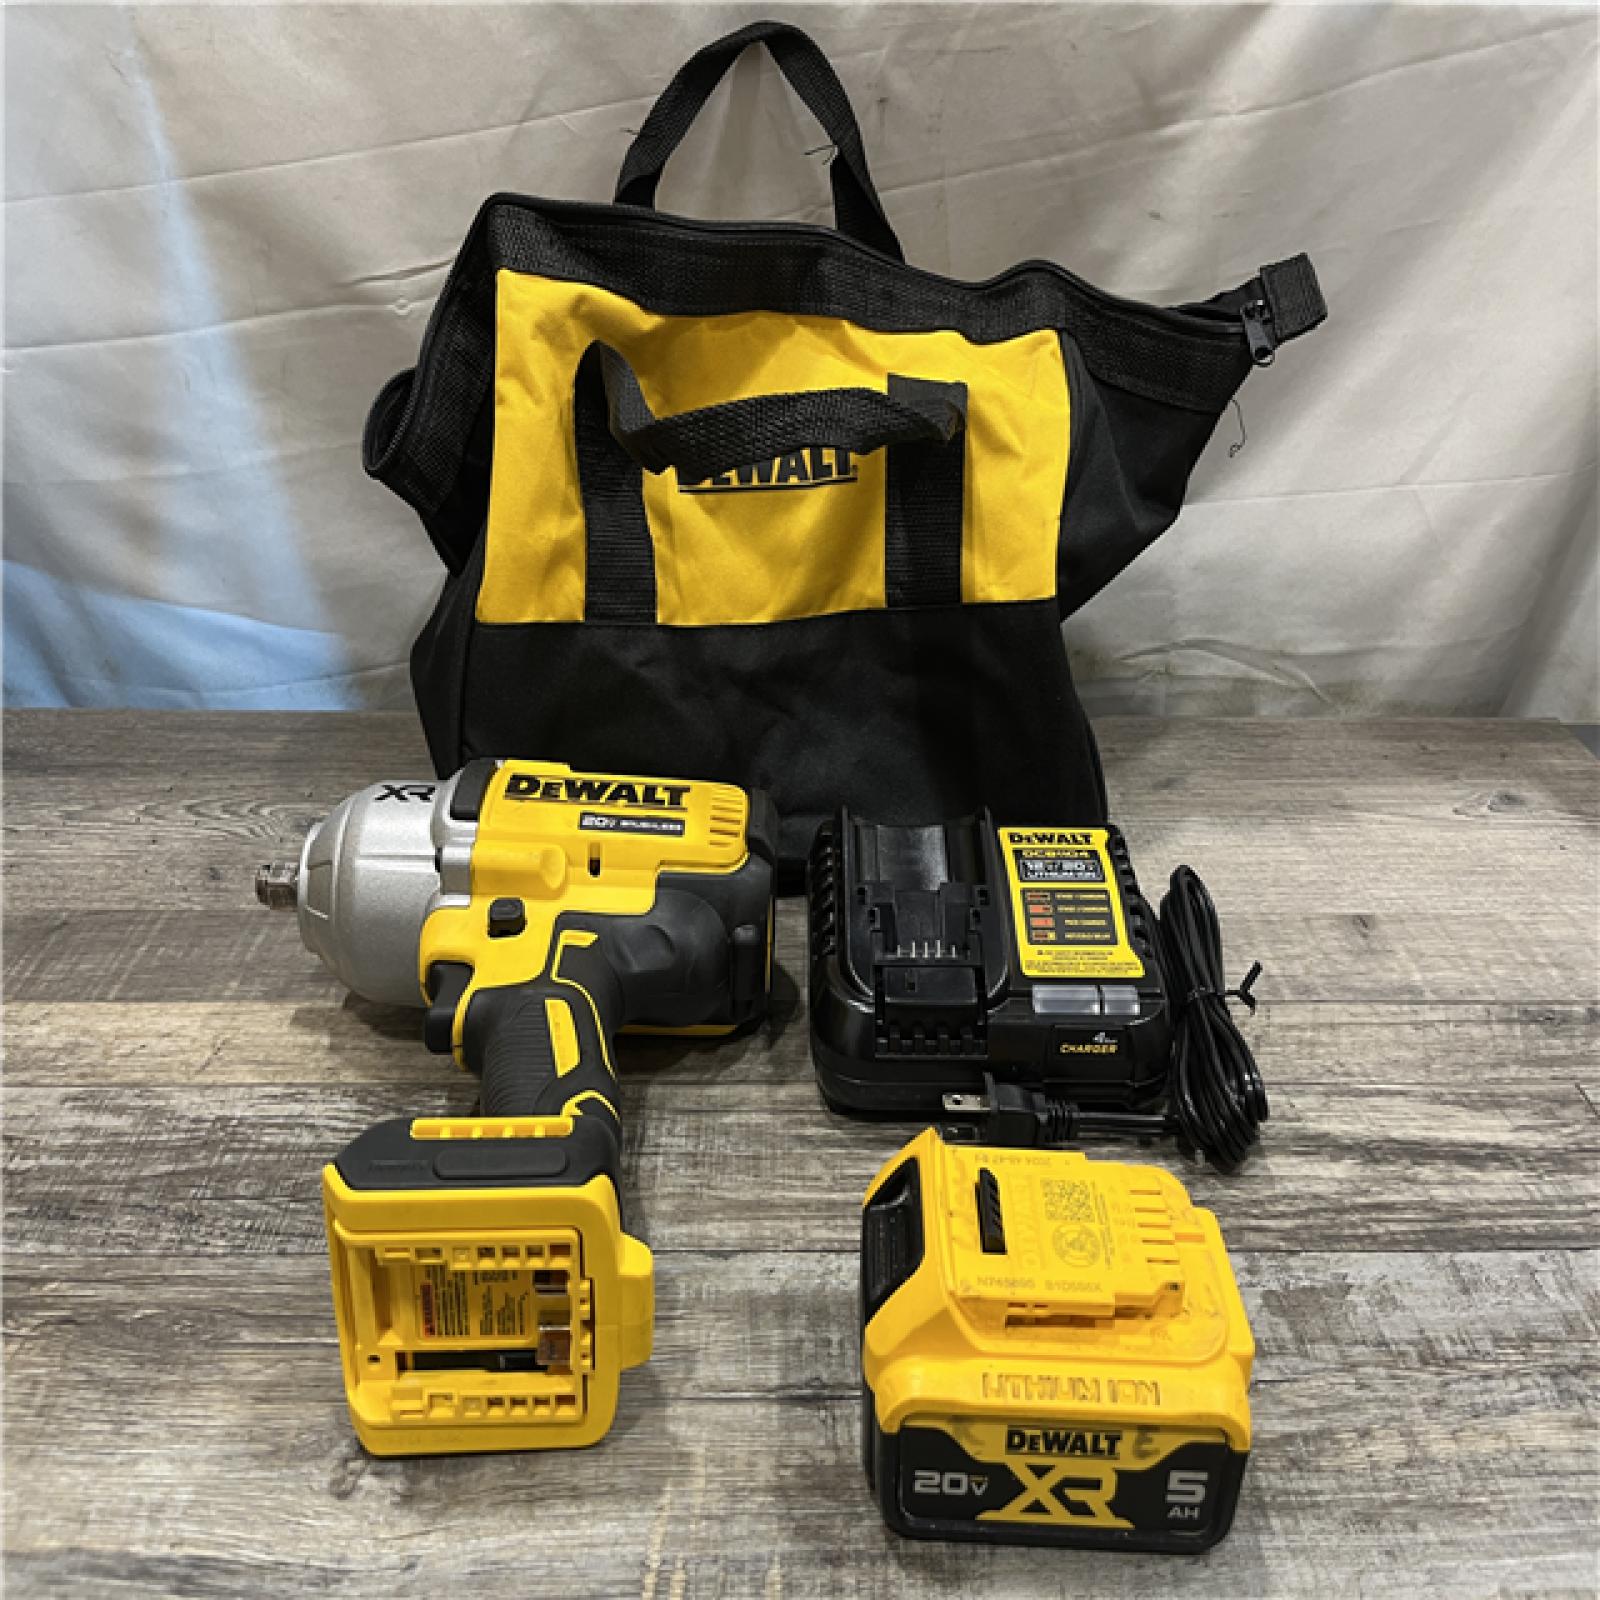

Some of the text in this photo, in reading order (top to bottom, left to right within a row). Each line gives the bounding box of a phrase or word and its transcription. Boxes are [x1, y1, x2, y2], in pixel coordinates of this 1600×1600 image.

[374, 784, 436, 801] XR
[503, 774, 691, 806] DEWALT
[1008, 832, 1093, 844] DEWALT
[982, 1372, 1161, 1406] LITHIUM ION
[1006, 1428, 1121, 1457] DEWALT
[975, 1463, 1136, 1529] XR
[1165, 1471, 1209, 1503] 5
[1167, 1505, 1200, 1519] AH
